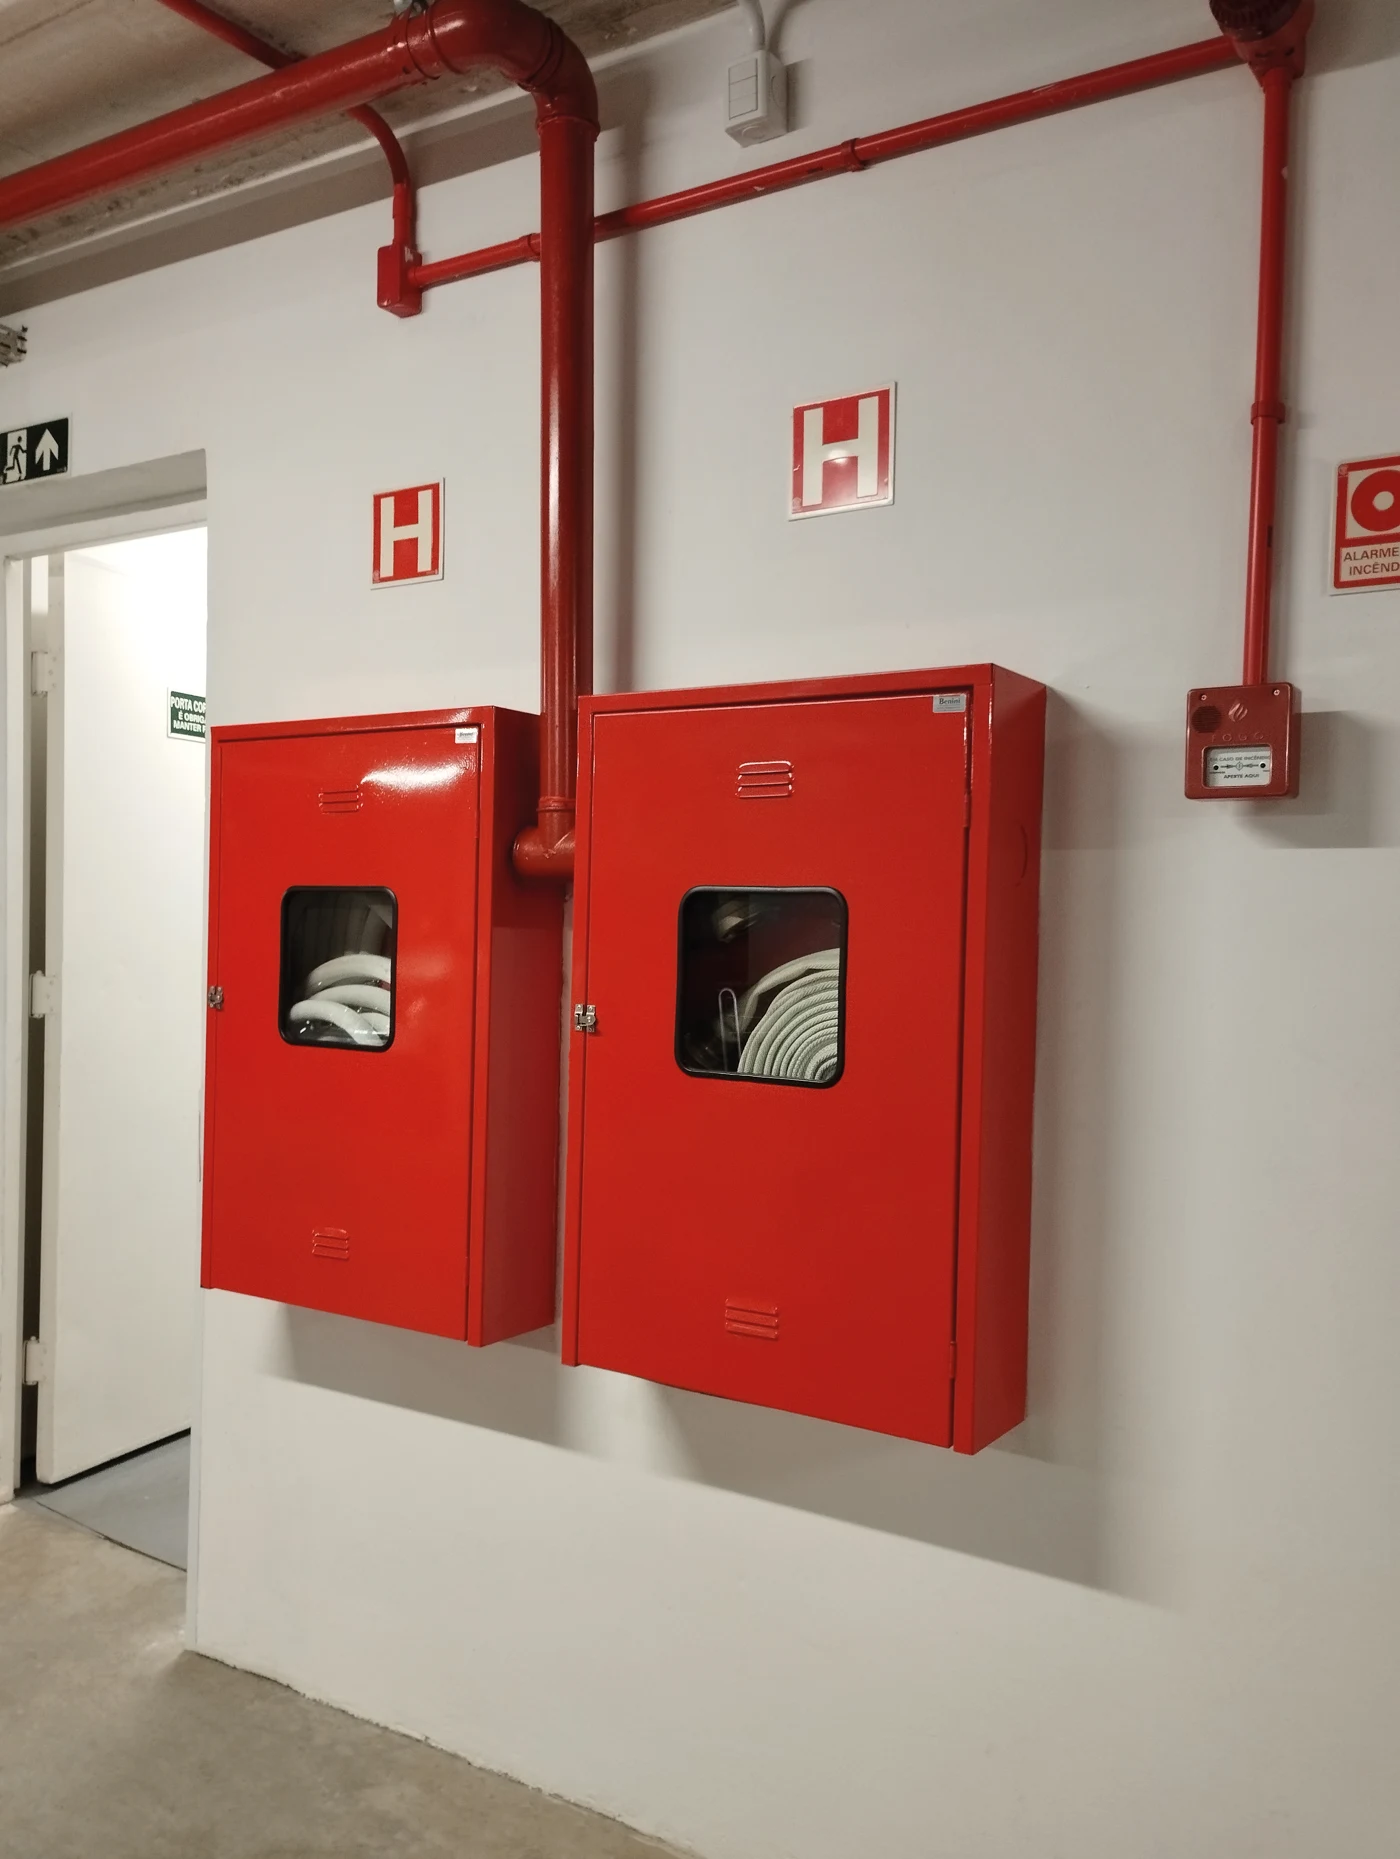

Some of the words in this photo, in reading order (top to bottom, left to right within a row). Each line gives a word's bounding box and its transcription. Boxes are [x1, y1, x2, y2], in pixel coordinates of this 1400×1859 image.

[802, 395, 879, 507] H
[379, 489, 433, 579] H
[1343, 547, 1399, 562] ALARME
[1349, 562, 1400, 576] INCÊND
[170, 696, 193, 711] PORTA
[184, 712, 206, 724] OBRIG
[173, 719, 202, 733] MANTER
